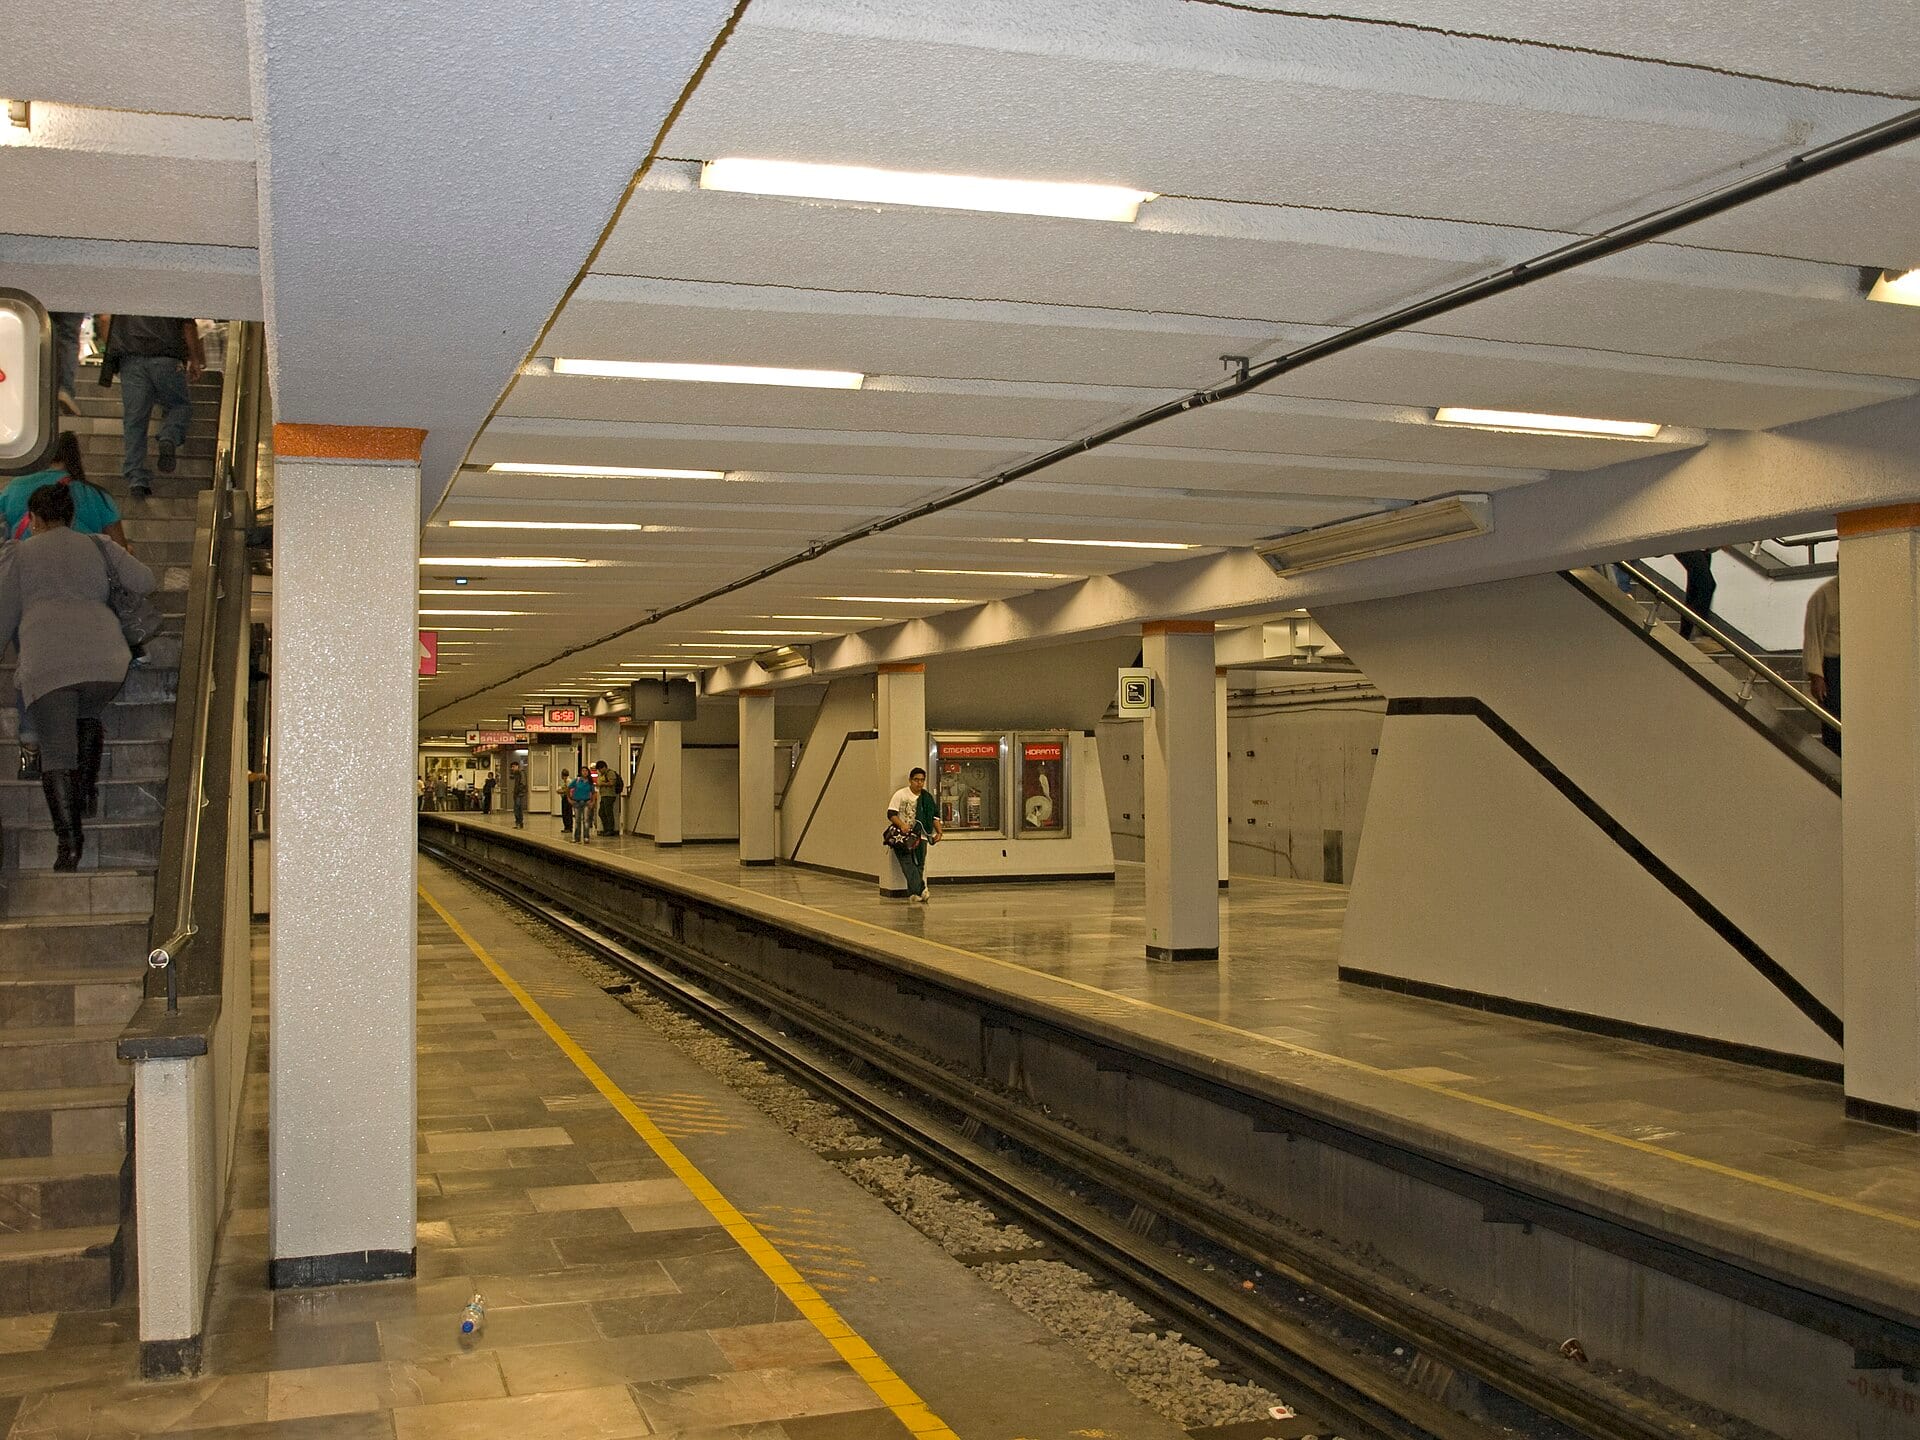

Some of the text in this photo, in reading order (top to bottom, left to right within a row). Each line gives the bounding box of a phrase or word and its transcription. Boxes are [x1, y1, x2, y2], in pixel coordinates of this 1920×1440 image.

[551, 710, 574, 721] 16:58
[943, 746, 994, 754] EMERGENCIA
[1025, 748, 1061, 756] HIDRANTE
